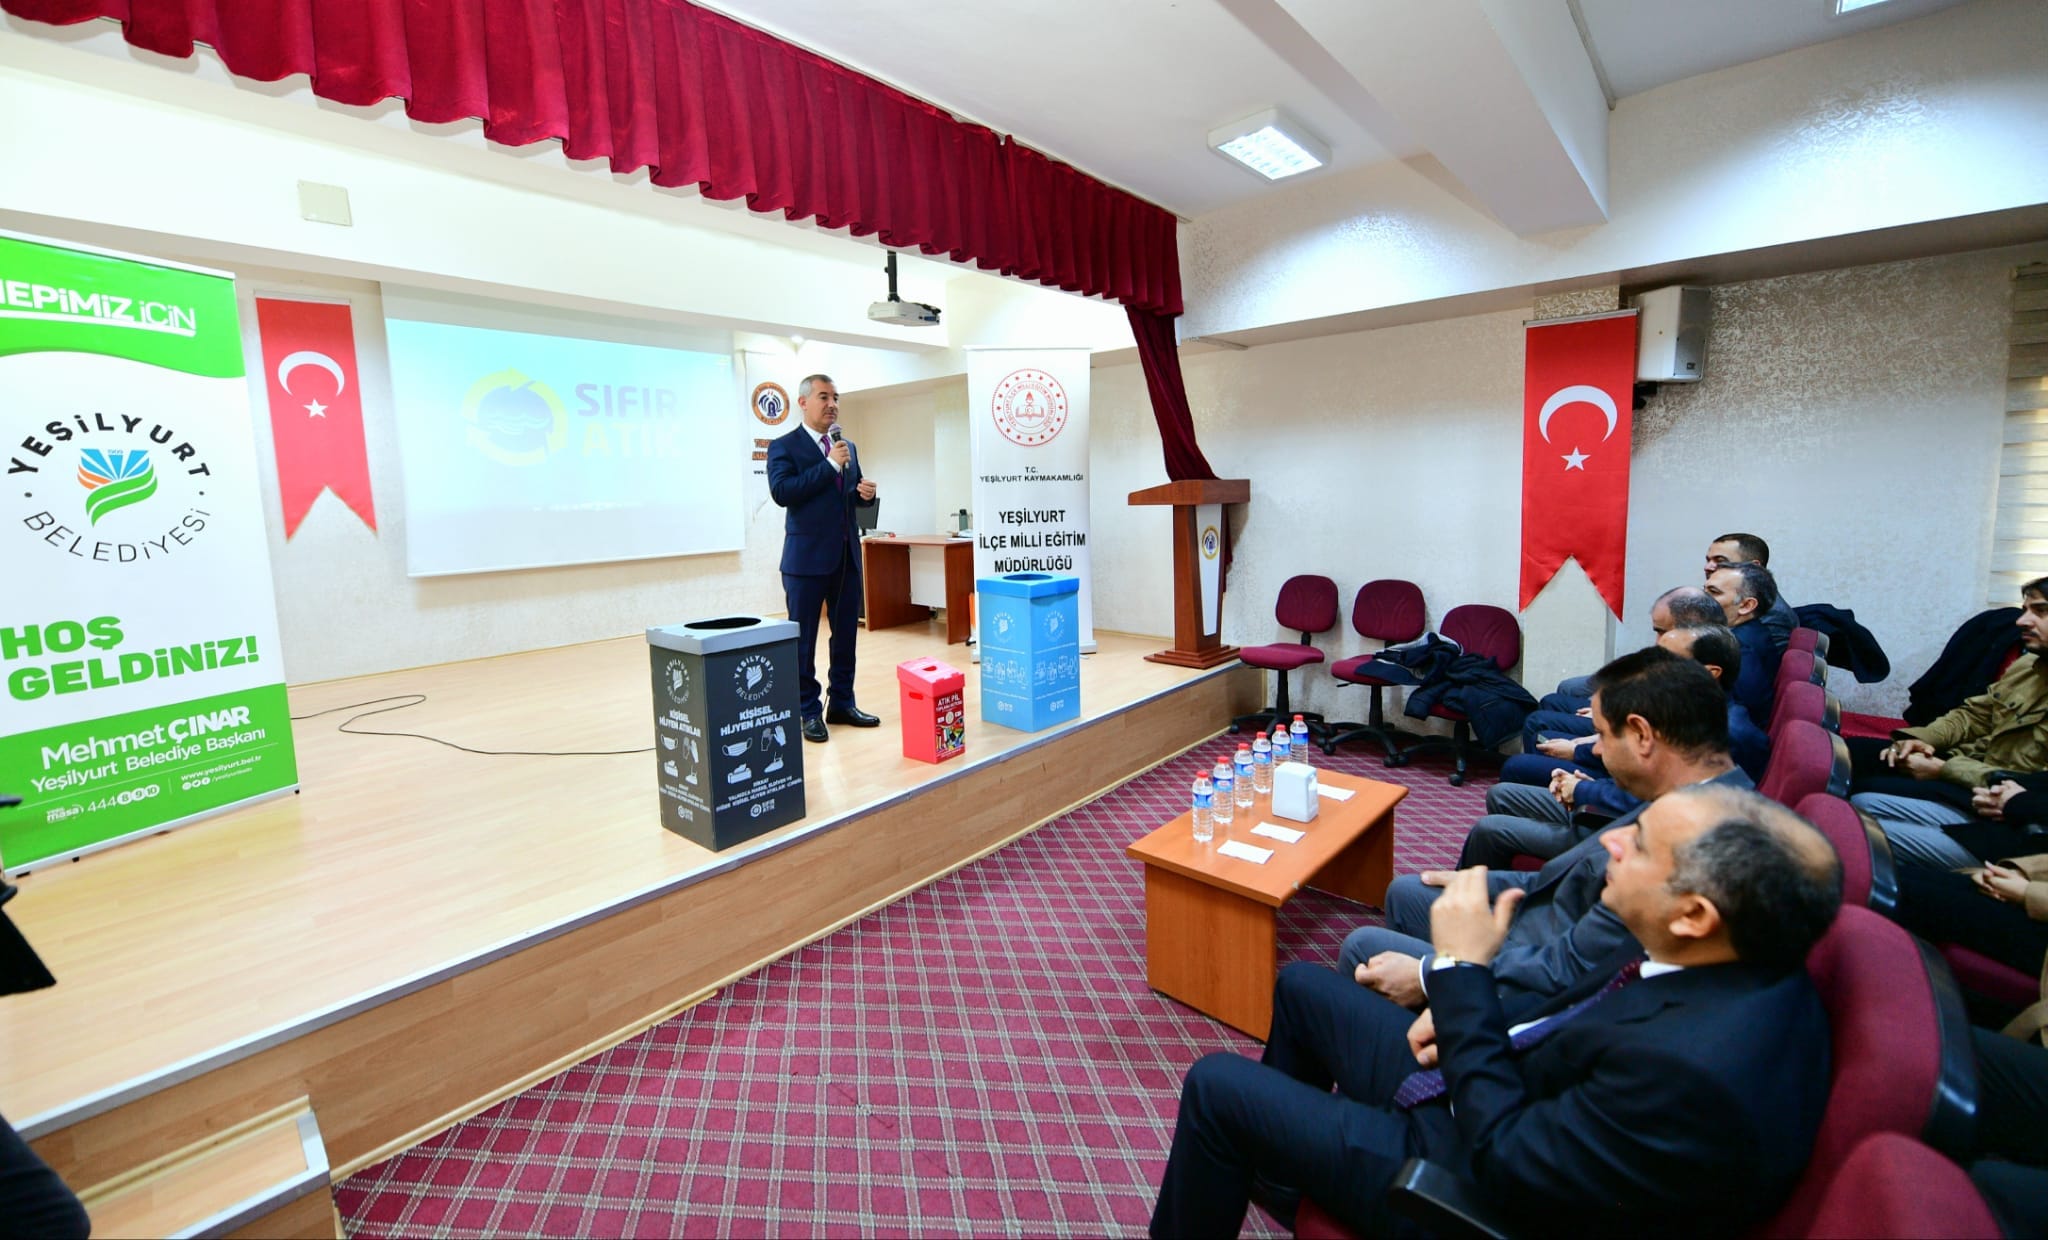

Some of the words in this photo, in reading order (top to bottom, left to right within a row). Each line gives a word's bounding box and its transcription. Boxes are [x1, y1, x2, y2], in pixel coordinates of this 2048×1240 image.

[575, 382, 678, 419] SIFIR
[980, 475, 1022, 484] YEŞİLYURT
[1025, 466, 1038, 474] T.C.
[999, 507, 1065, 526] YEŞİLYURT
[979, 534, 1006, 551] İLÇE
[1010, 533, 1042, 549] MİLLİ
[1045, 531, 1086, 548] EĞİTİM
[994, 555, 1072, 573] MÜDÜRLÜĞÜ
[0, 615, 124, 660] HOŞ
[720, 720, 754, 736] HİJYEN
[755, 710, 791, 726] ATIKLAR
[41, 724, 166, 770] Mehmet
[168, 706, 250, 744] ÇINAR
[31, 762, 118, 794] Yeşilyurt
[126, 742, 201, 772] Belediye
[206, 728, 265, 752] Başkanı
